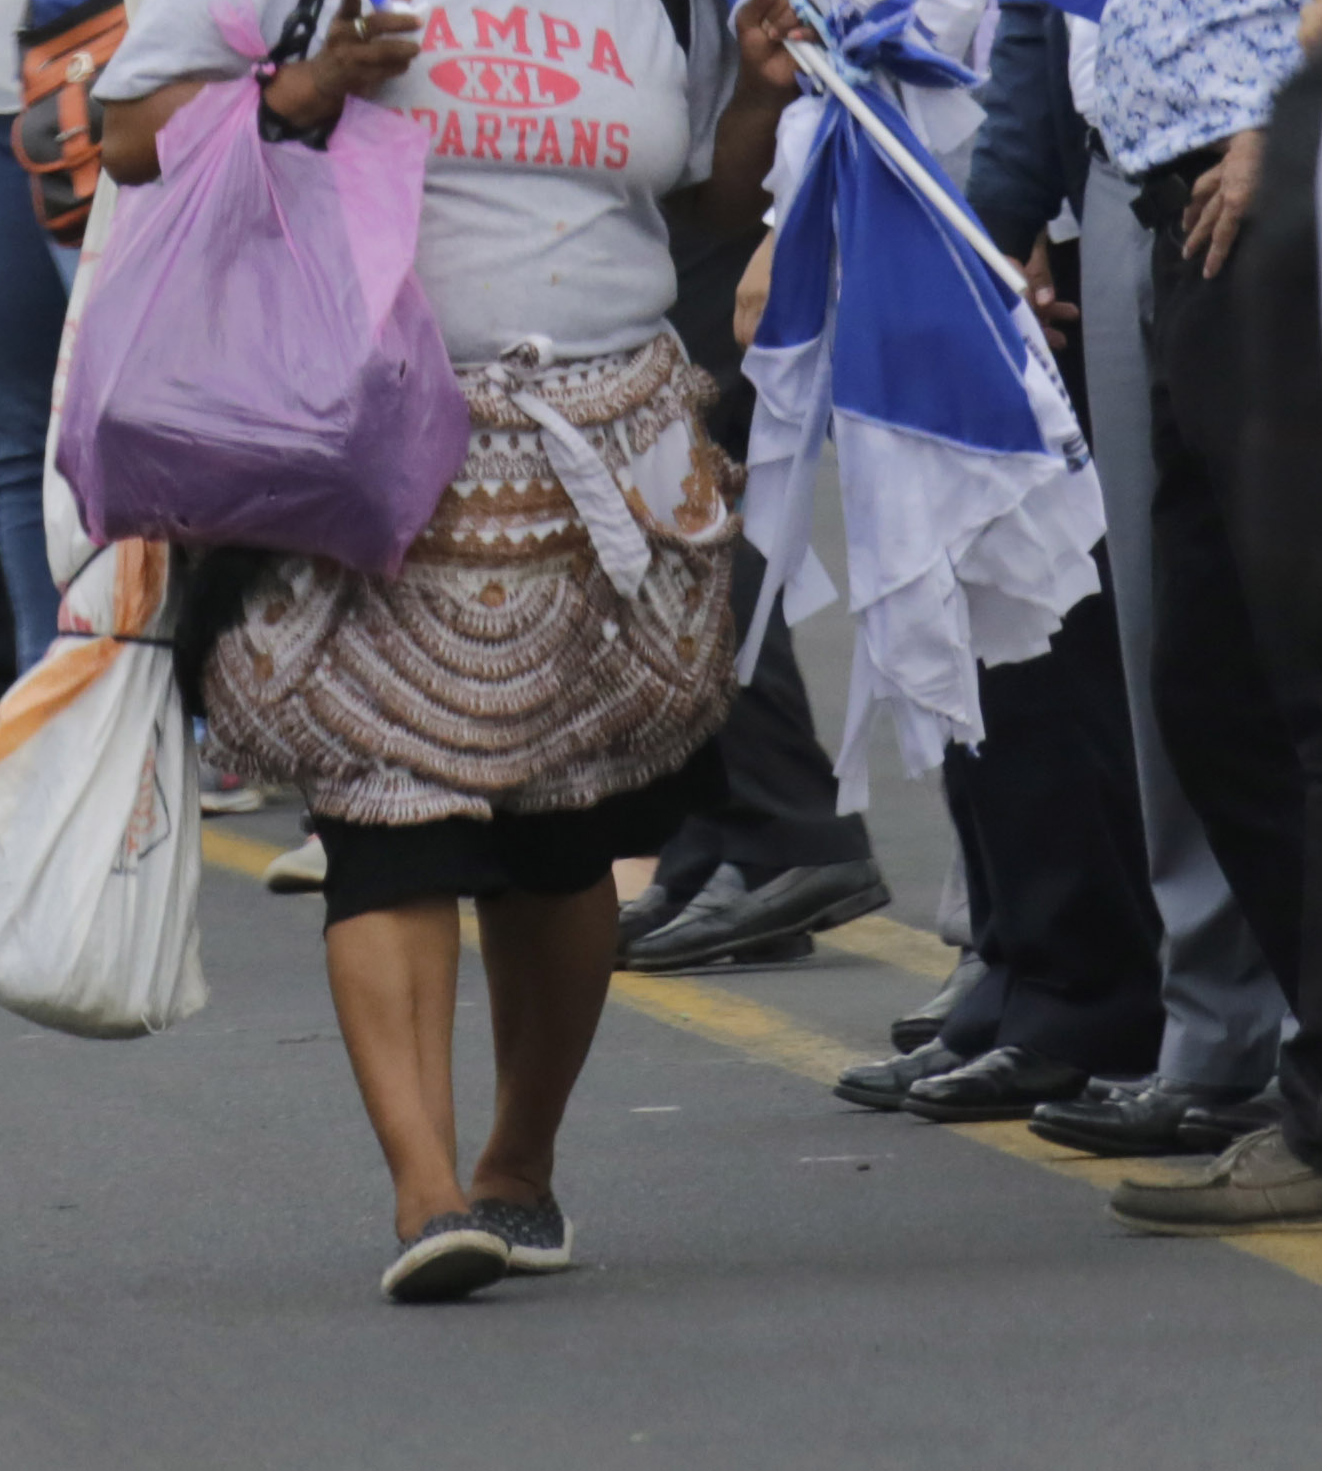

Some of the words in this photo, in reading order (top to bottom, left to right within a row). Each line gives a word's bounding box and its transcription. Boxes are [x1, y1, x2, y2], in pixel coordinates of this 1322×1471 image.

[420, 5, 635, 89] AMPA
[457, 60, 556, 106] XXL
[394, 106, 631, 171] PARTANS
